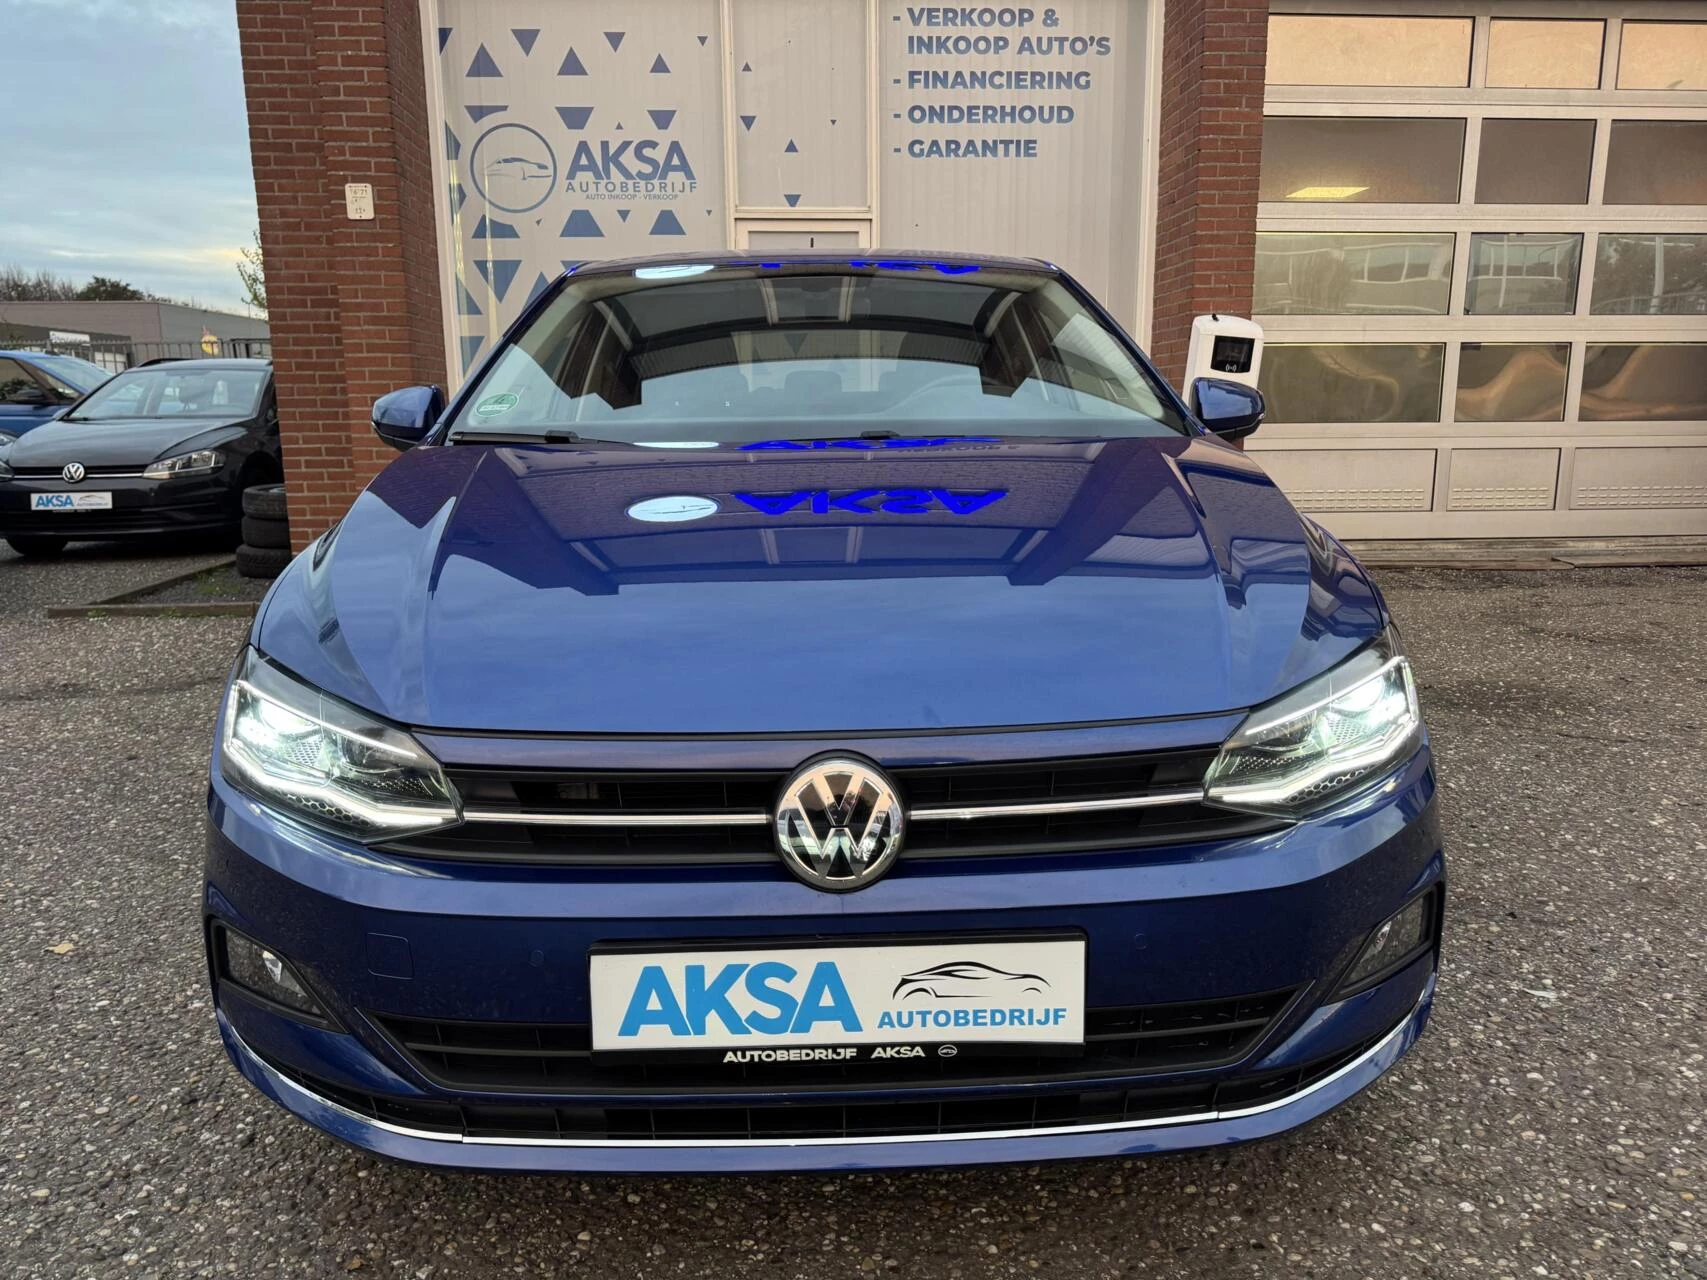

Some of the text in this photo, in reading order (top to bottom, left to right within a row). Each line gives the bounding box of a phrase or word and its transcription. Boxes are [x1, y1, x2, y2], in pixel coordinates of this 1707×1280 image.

[907, 8, 1034, 27] VERKOOP
[1042, 8, 1060, 27] &
[907, 35, 1111, 55] INKOOP AUTO'S
[907, 71, 1091, 89] FINANCIERING
[907, 105, 1074, 124] ONDERHOUD
[907, 139, 1037, 158] GARANTIE
[565, 140, 696, 181] AKSA
[565, 181, 697, 193] AUTOBEDRIJF
[35, 495, 74, 508] AKSA
[618, 962, 863, 1036] AKSA
[877, 1007, 1067, 1029] AUTOBEDRIJF
[723, 1046, 926, 1063] AUTOBEDRIJF AKSA
